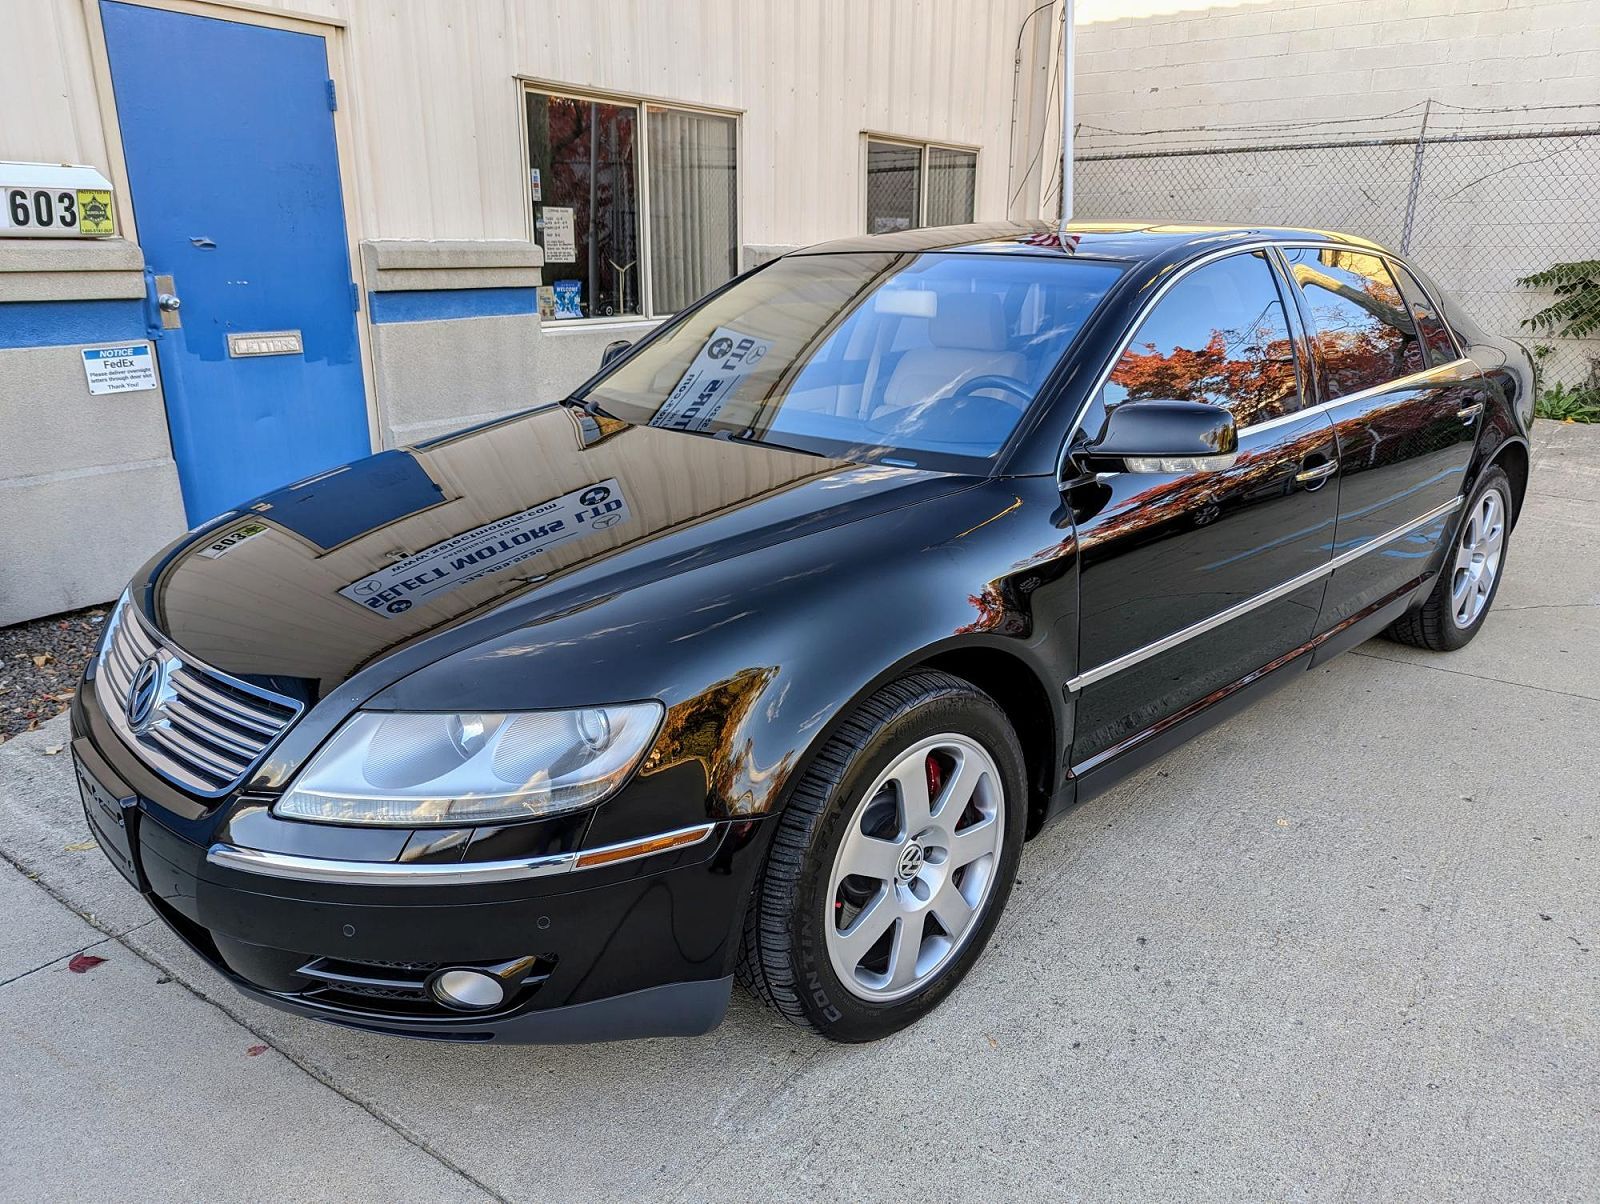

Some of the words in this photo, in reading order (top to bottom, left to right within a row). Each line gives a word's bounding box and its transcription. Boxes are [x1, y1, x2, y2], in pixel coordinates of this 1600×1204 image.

[10, 189, 77, 227] 603
[99, 348, 133, 358] NOTICE
[104, 359, 135, 369] FedEx
